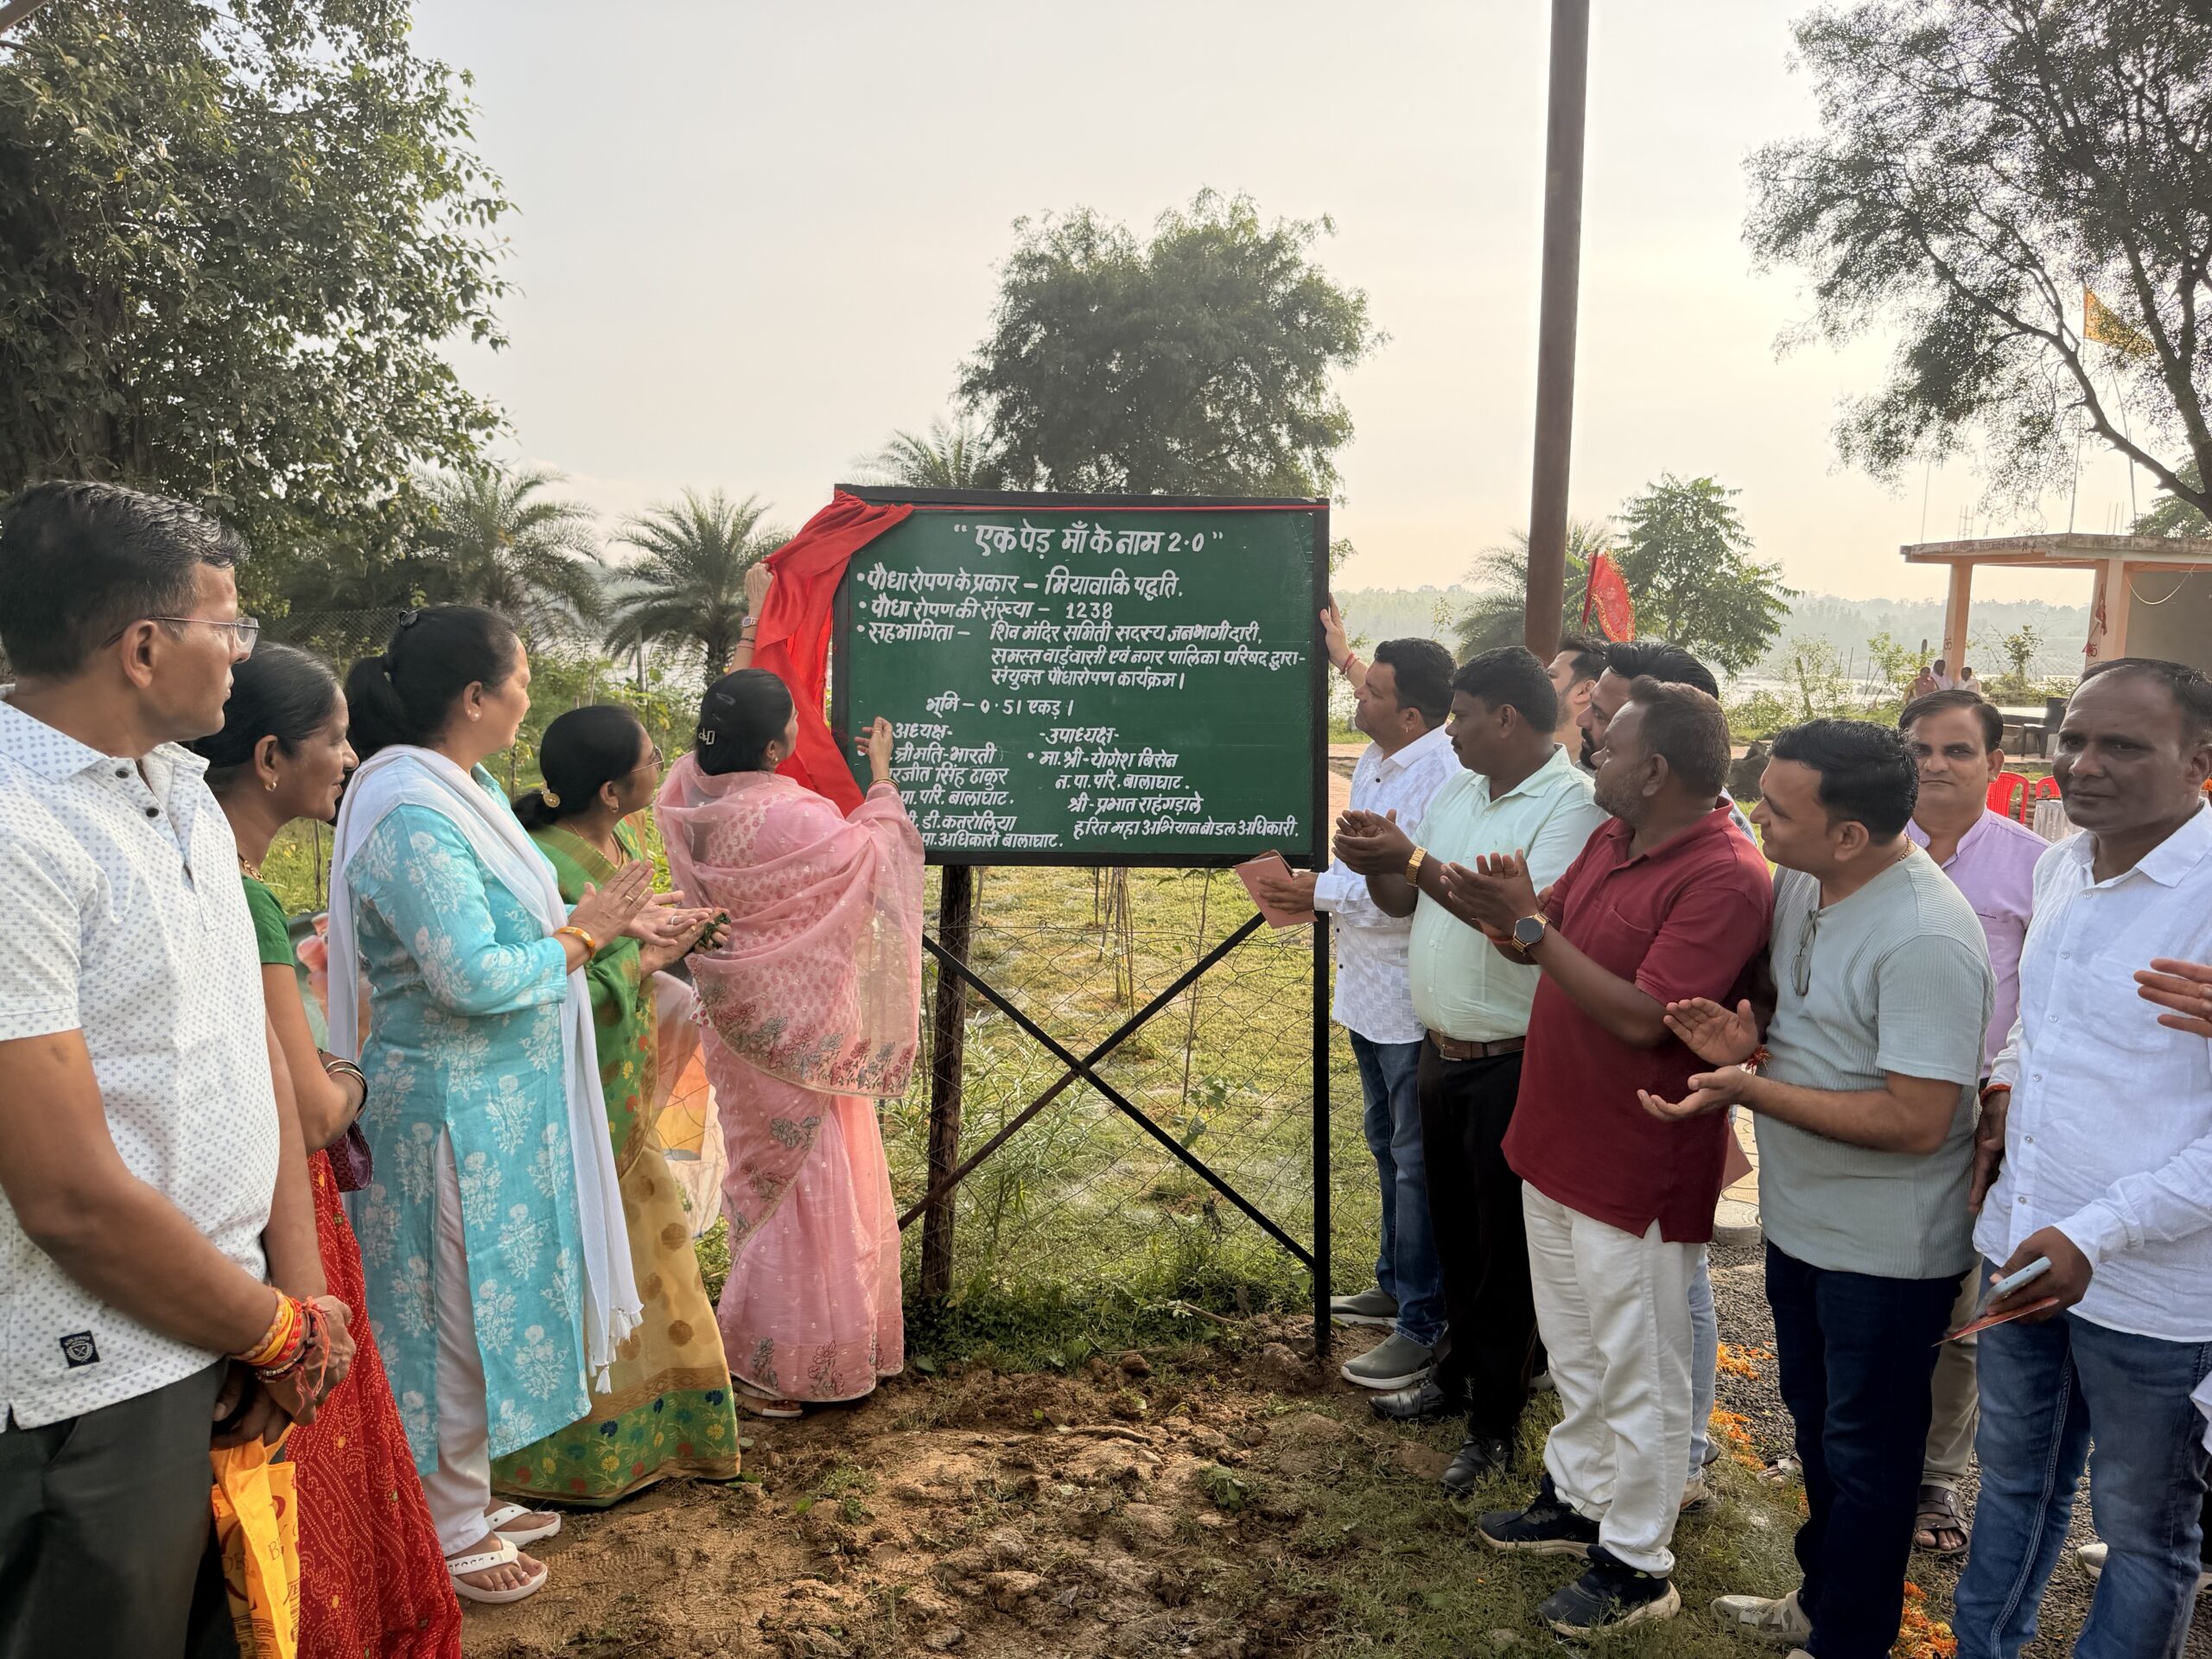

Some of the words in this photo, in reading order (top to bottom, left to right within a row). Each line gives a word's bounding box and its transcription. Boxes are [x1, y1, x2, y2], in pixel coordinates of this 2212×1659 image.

[1020, 518, 1056, 560] पेड़
[1061, 519, 1090, 555] माँ
[1090, 523, 1115, 555] के
[1116, 530, 1166, 556] नाम
[969, 573, 1020, 594] प्रकार
[1065, 601, 1114, 620] 1238
[989, 620, 1023, 643] शिव
[1021, 619, 1062, 644] मंदिर
[1063, 619, 1115, 643] समिती
[1115, 624, 1168, 643] सदस्य
[991, 647, 1045, 665] समस्त
[1108, 645, 1132, 664] एवं
[1130, 650, 1166, 665] नगर
[1167, 644, 1222, 666] पालिका
[1224, 644, 1270, 667] परिषद
[991, 664, 1046, 691] संयुक्त
[1047, 665, 1117, 687] पौधारोपण
[1137, 747, 1179, 769] बिसेन
[934, 760, 969, 789] सिंह
[969, 767, 1010, 791] ठाकुर
[1073, 816, 1112, 841] हरित
[1110, 821, 1141, 840] महा
[1141, 814, 1202, 836] अभियान
